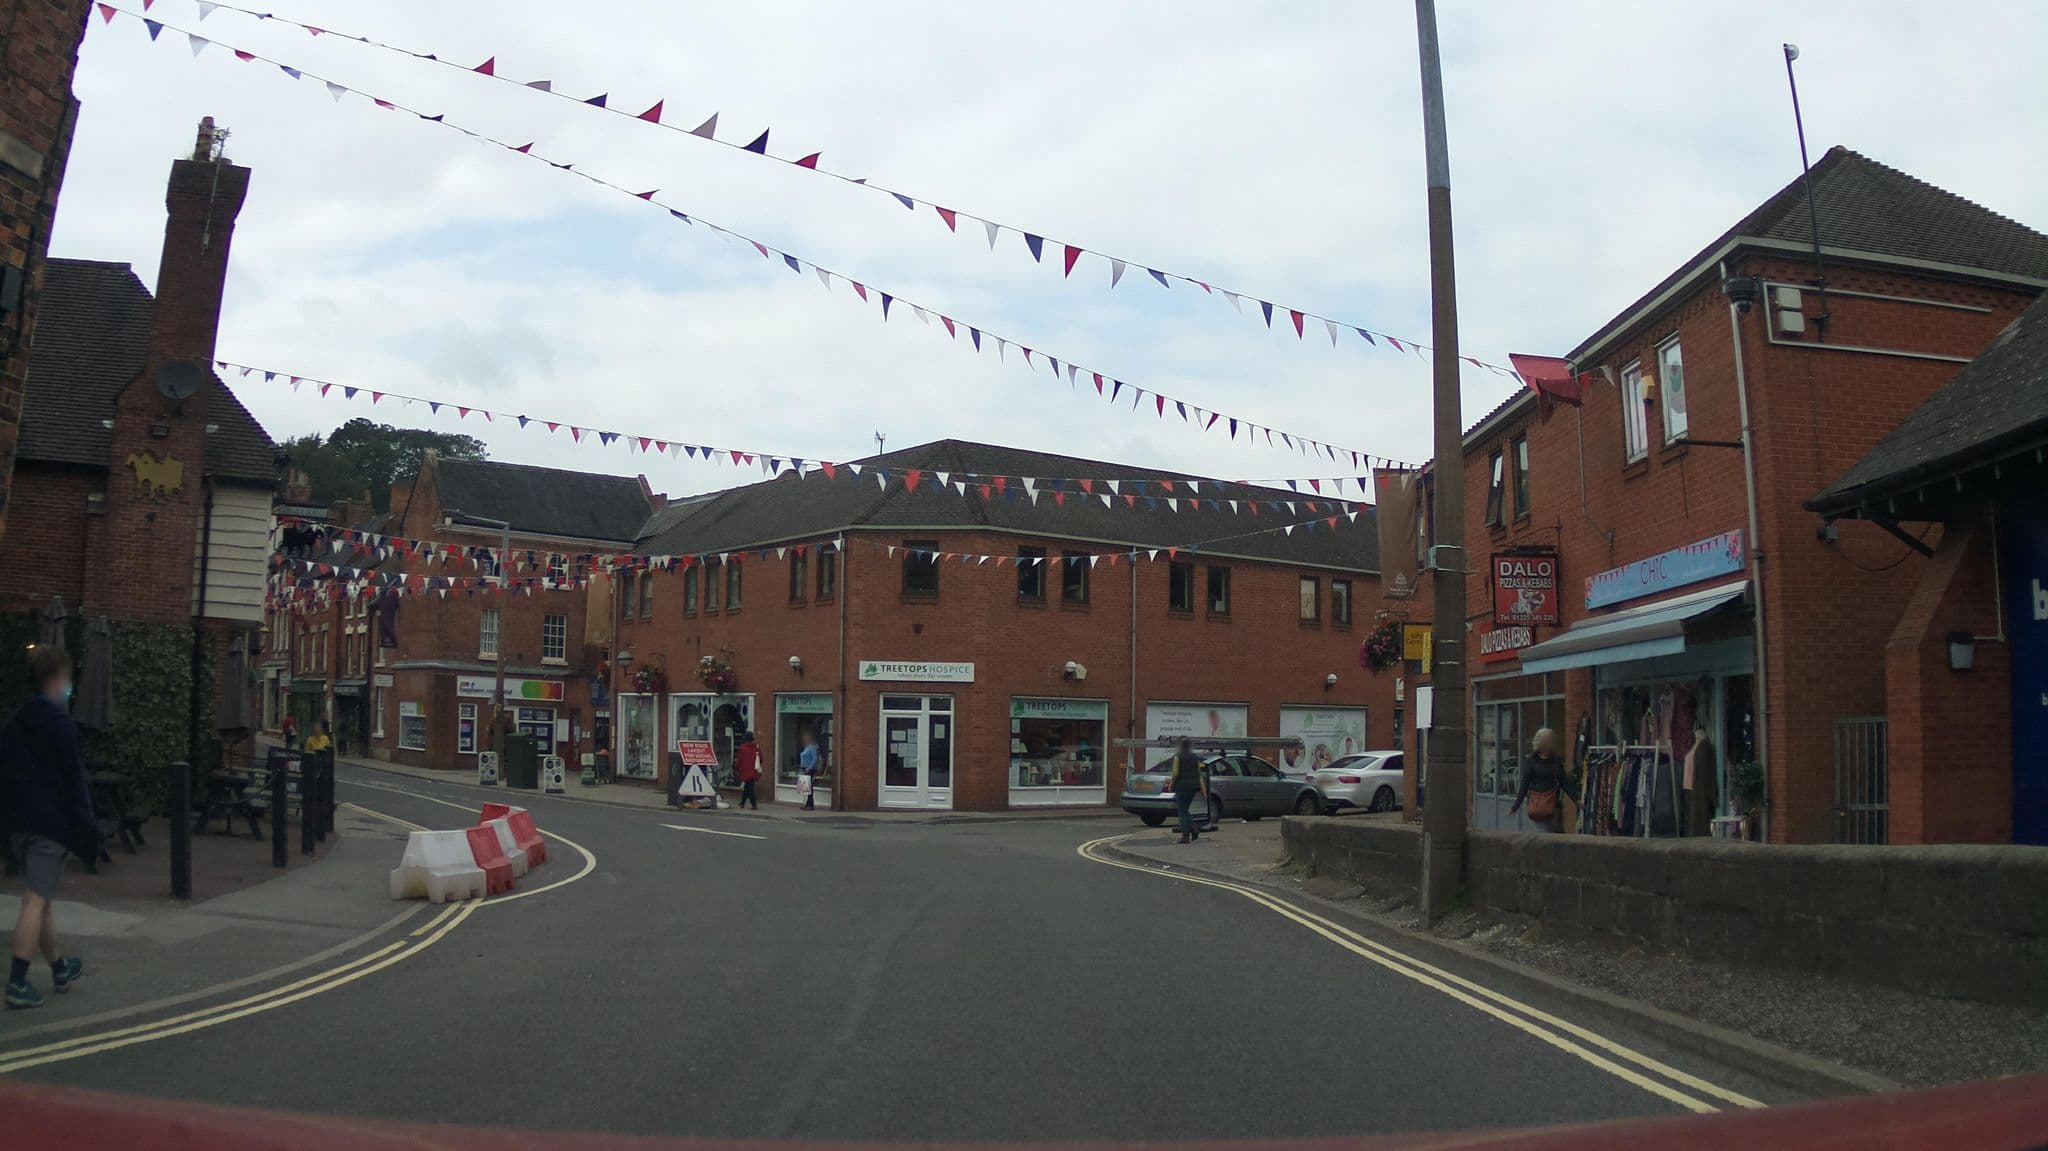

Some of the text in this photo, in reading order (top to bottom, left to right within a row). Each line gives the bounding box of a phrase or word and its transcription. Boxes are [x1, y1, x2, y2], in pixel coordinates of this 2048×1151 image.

[1500, 561, 1552, 577] DALO
[1640, 555, 1668, 585] CHIC
[1499, 577, 1521, 589] PIZZAS
[1528, 578, 1553, 589] KEBABS
[1480, 631, 1492, 654] DALO
[1492, 628, 1508, 652] PIZZAS
[1512, 626, 1531, 649] KEBABS
[880, 664, 969, 674] TREETOPS HOSPICE
[1027, 702, 1067, 711] TREETOPS
